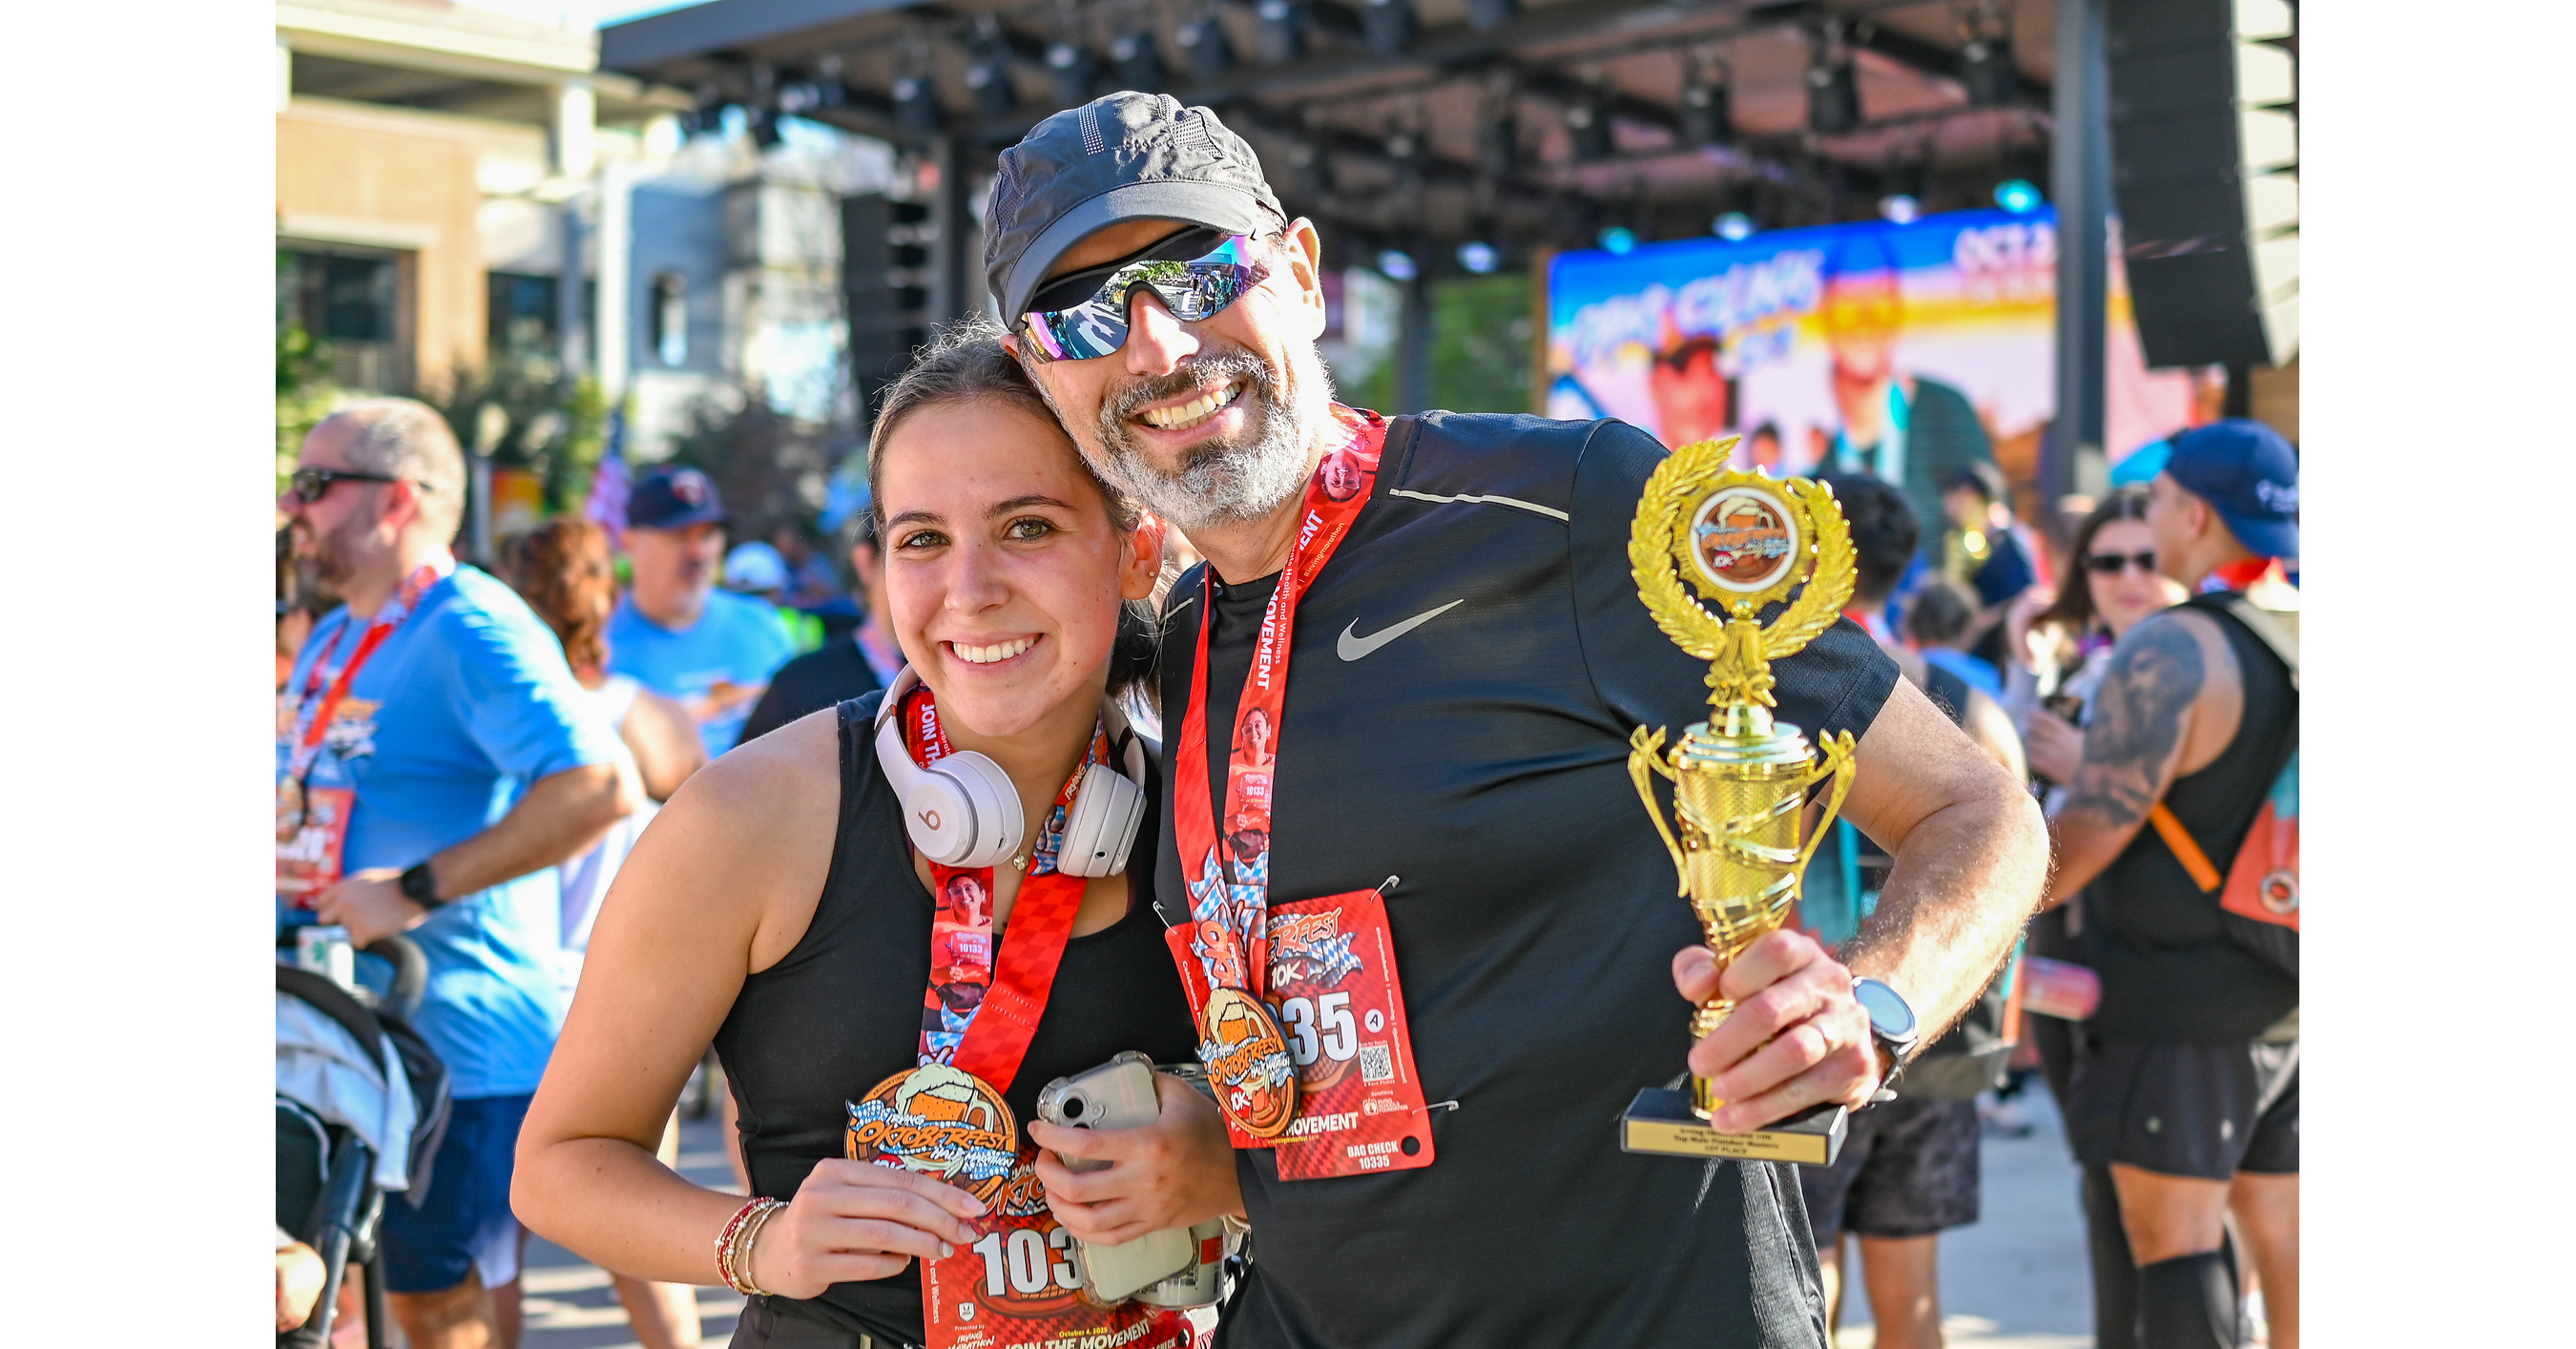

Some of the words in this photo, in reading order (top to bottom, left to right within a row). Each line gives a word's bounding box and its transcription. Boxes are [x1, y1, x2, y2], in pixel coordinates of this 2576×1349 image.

[1282, 569, 1292, 600] Health
[1276, 623, 1286, 664] Wellness
[922, 704, 937, 740] JOIN
[925, 741, 941, 766] TH
[1246, 786, 1264, 796] 10133
[959, 944, 983, 954] 10133
[1272, 960, 1304, 990] 10K
[1269, 991, 1359, 1067] 35
[1369, 1013, 1379, 1027] A
[1212, 1036, 1278, 1084] OKTOBERFEST
[1231, 1090, 1251, 1112] 10K
[885, 1114, 926, 1127] IRVING
[856, 1120, 1013, 1149] OKTOBERFEST
[930, 1148, 964, 1160] HALF
[965, 1152, 1015, 1169] MARATHON
[1347, 1144, 1367, 1158] BAG
[1367, 1140, 1399, 1155] CHECK
[1359, 1154, 1390, 1170] 10335
[957, 1330, 983, 1344] IRVING
[1045, 1338, 1077, 1349] THE
[1079, 1319, 1150, 1349] MOVEMENT
[1059, 1329, 1084, 1339] October
